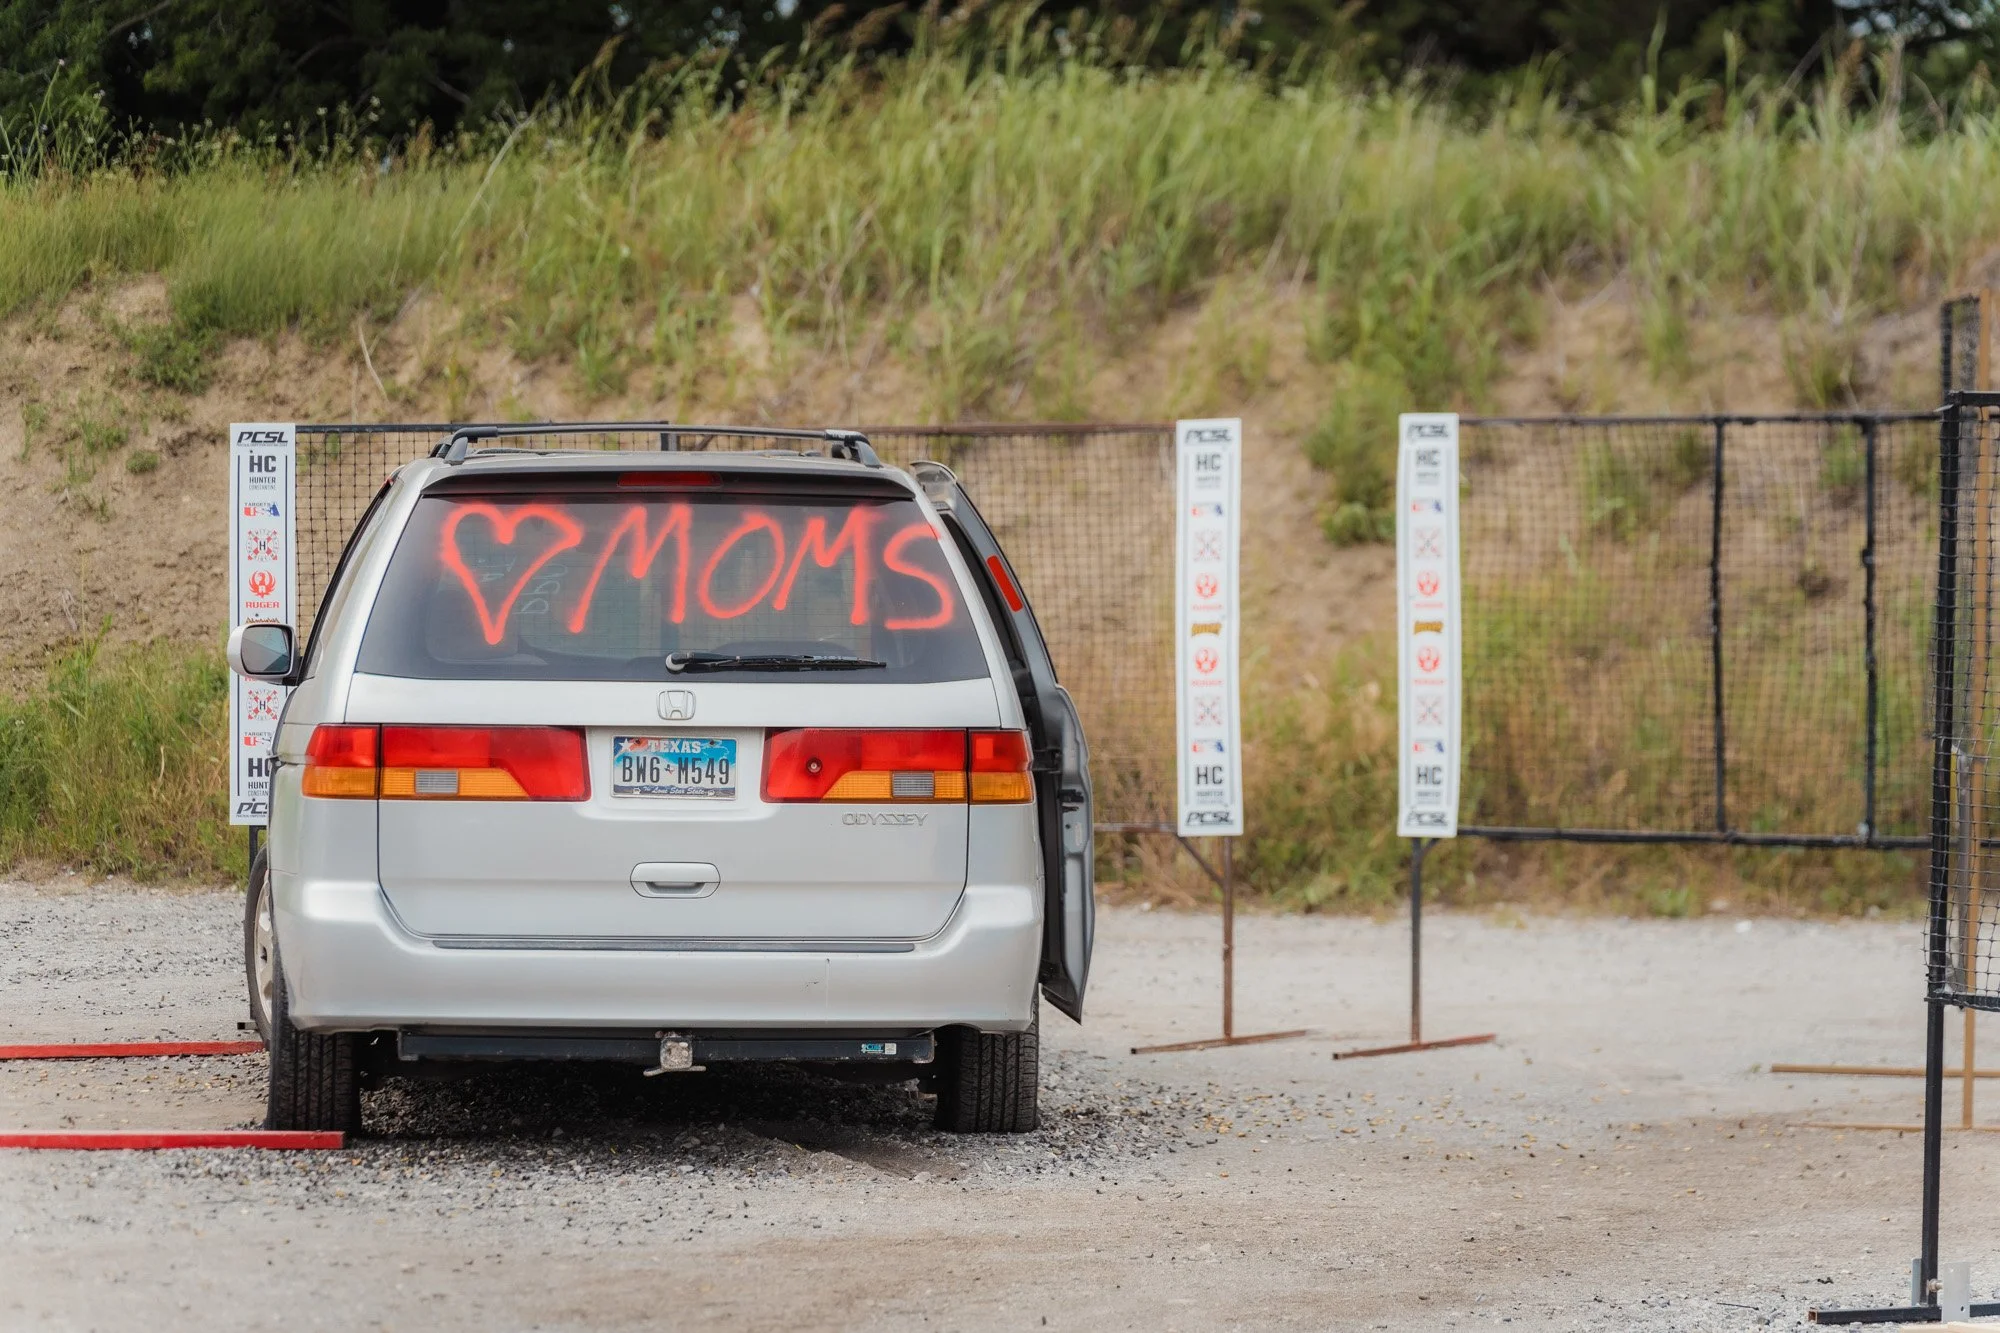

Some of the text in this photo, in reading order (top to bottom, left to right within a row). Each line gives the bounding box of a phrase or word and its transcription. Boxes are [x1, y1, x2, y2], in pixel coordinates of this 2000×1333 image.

[237, 431, 288, 443] PCSL
[1185, 429, 1232, 443] PCSL
[249, 455, 276, 473] HC
[1196, 454, 1221, 471] HC
[259, 540, 266, 551] H
[568, 504, 952, 634] MOMS
[648, 740, 702, 753] TEXAS
[622, 755, 730, 785] BW6 M549
[1196, 766, 1223, 784] HC
[1416, 766, 1442, 784] HC
[842, 812, 929, 826] ODYSSEY
[1186, 811, 1233, 823] PCSL
